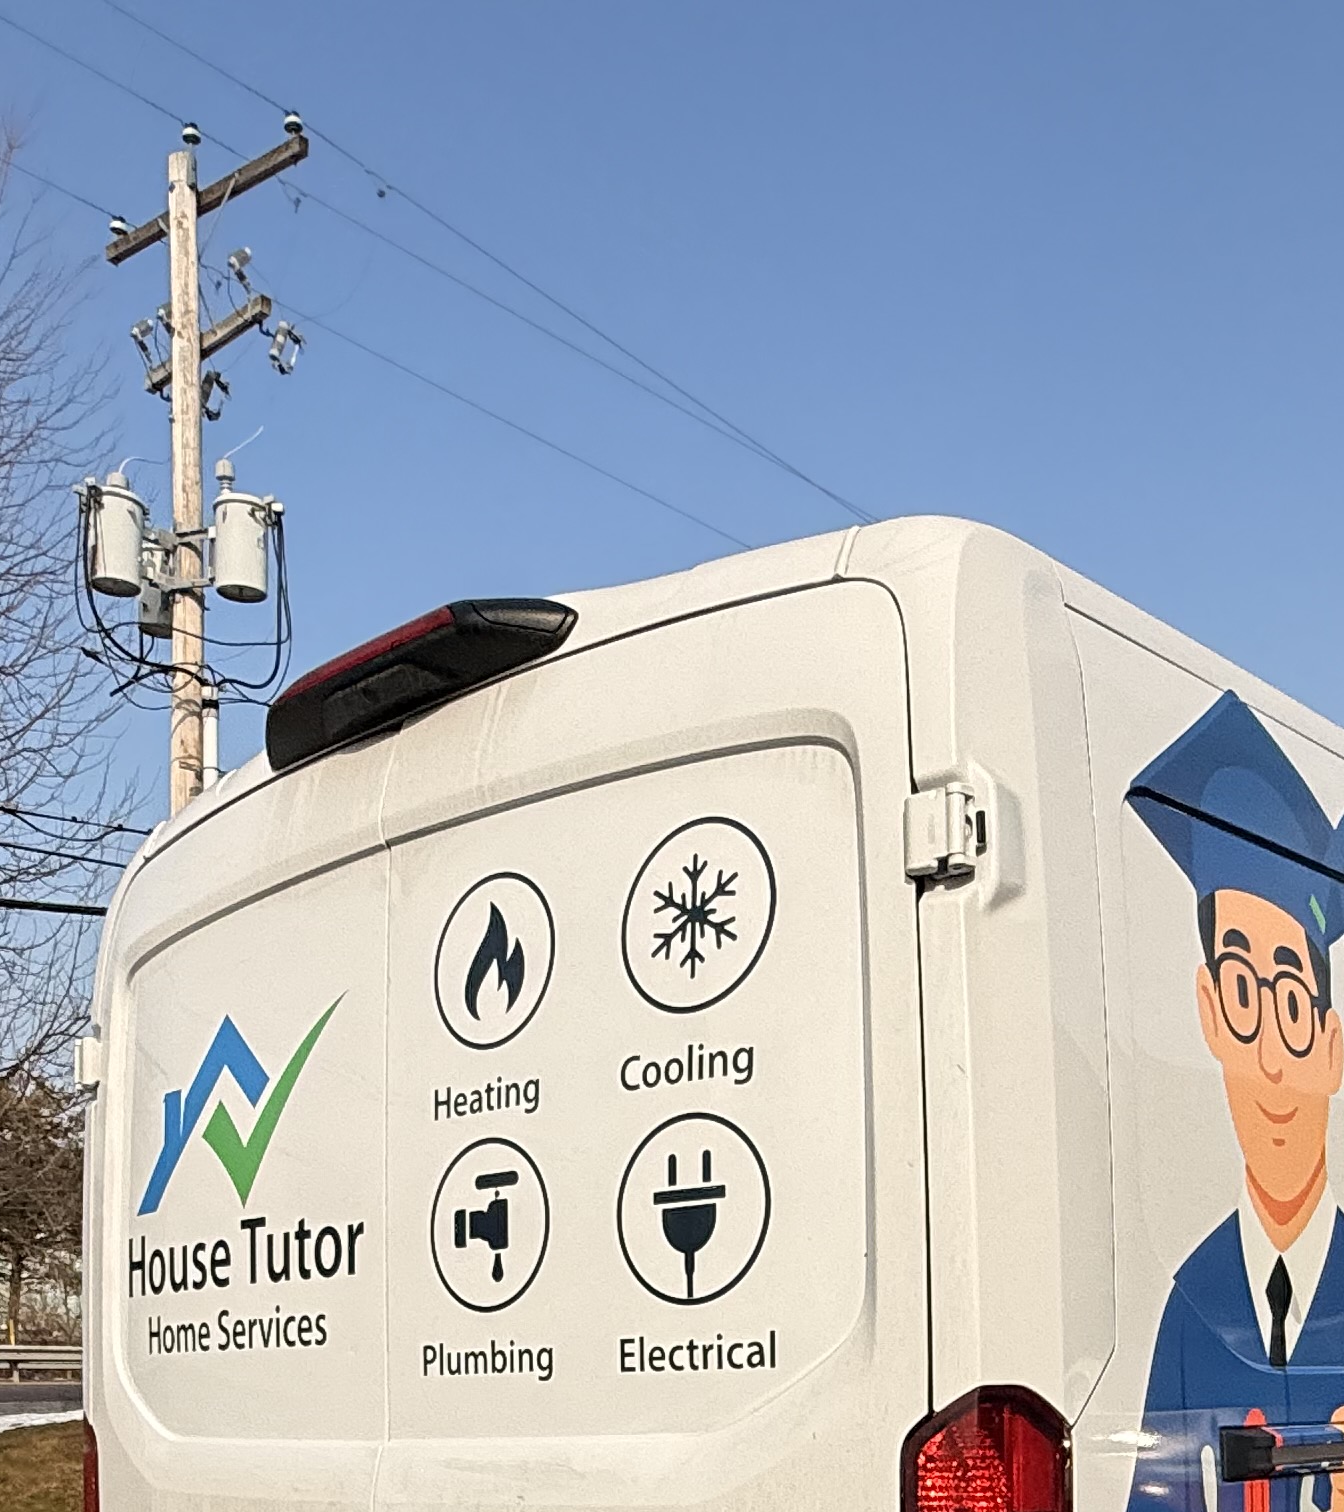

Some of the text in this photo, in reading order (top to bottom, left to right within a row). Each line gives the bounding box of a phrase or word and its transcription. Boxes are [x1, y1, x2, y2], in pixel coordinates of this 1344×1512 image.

[620, 1042, 756, 1092] Cooling
[433, 1074, 541, 1121] Heating
[128, 1217, 365, 1299] House Tutor
[147, 1306, 328, 1356] Home Services
[619, 1332, 778, 1374] Electrical
[422, 1340, 554, 1382] Plumbing
